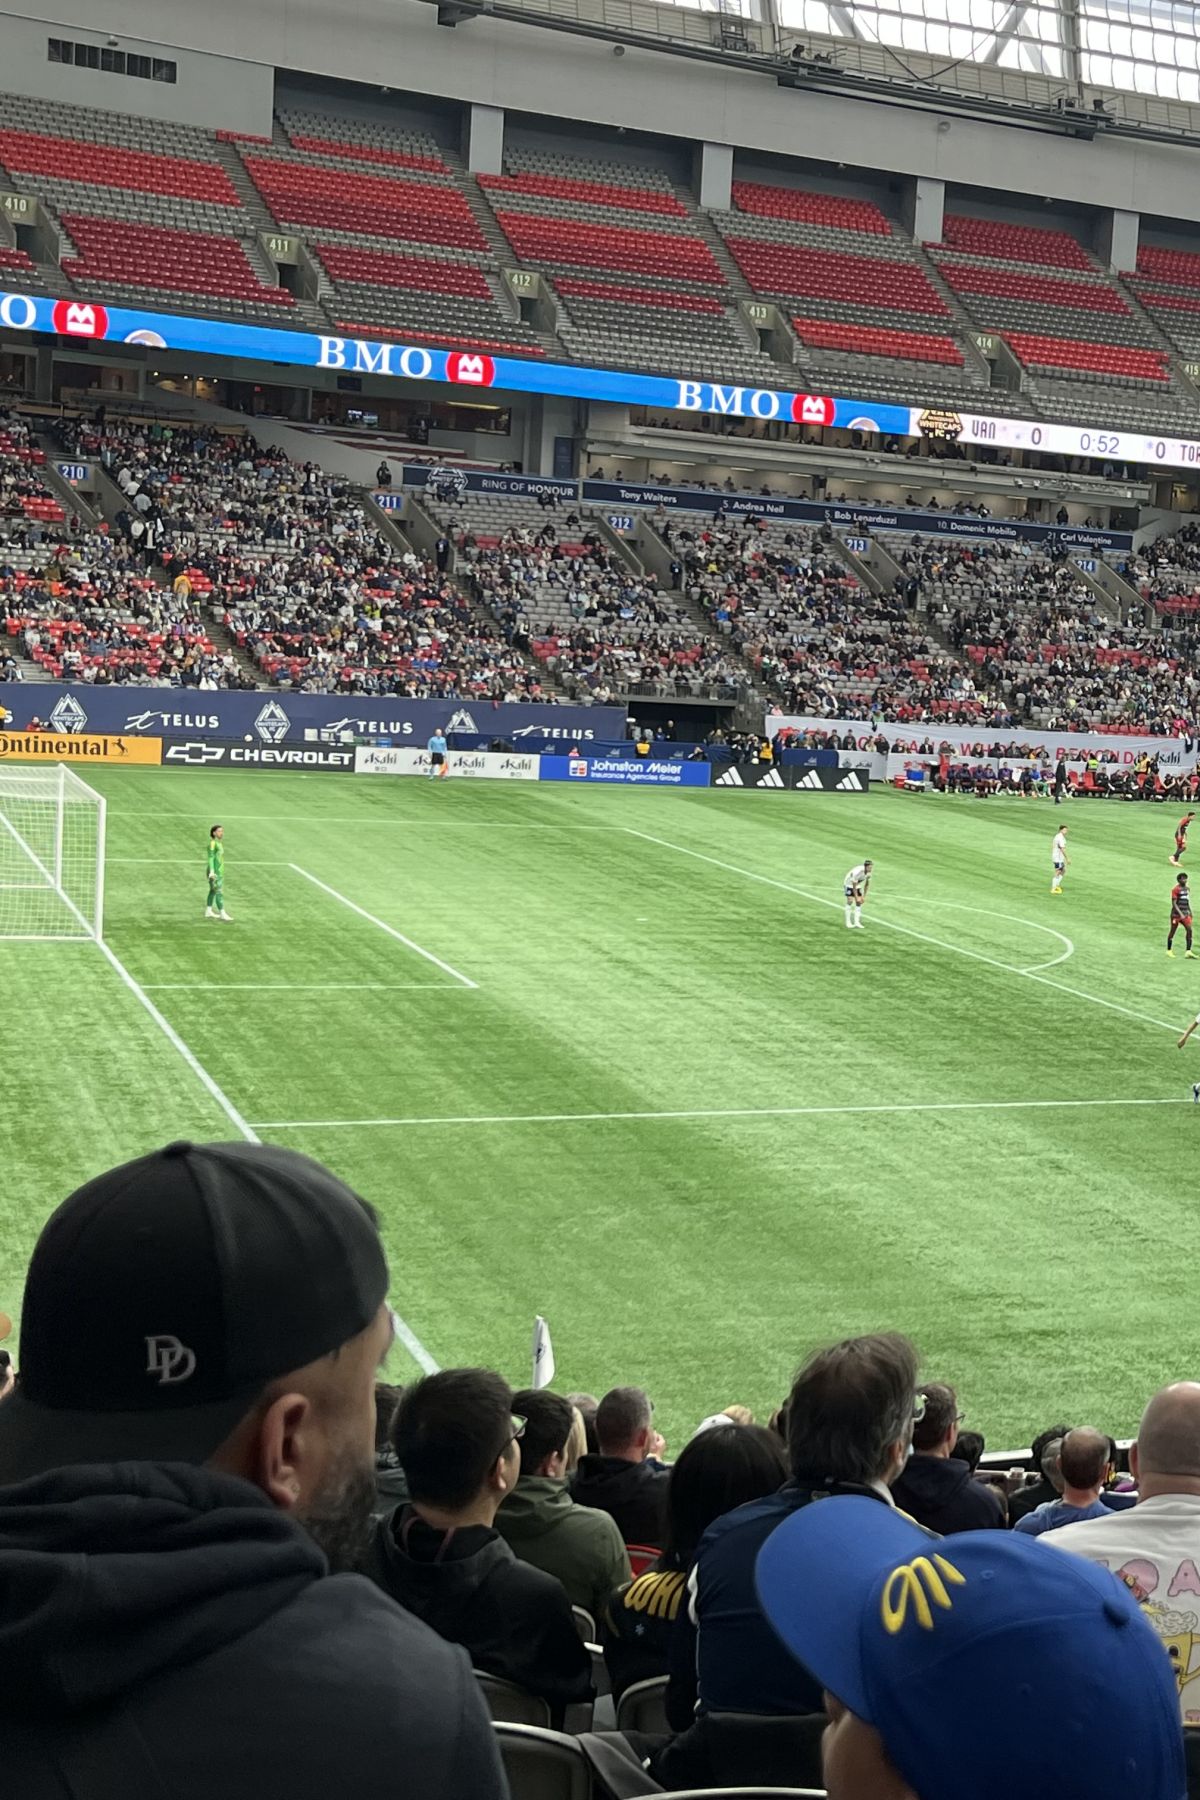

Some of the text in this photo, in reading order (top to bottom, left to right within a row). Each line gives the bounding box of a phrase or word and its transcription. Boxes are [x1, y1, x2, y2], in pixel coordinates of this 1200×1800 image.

[6, 198, 27, 213] 410
[269, 238, 289, 252] 411
[512, 274, 531, 287] 412
[750, 306, 767, 319] 413
[976, 336, 991, 348] 414
[317, 336, 432, 378] BMO
[676, 381, 779, 420] BMO
[972, 420, 996, 440] VAN
[1080, 433, 1120, 455] 0:52
[61, 465, 84, 480] 210
[481, 478, 574, 497] RING OF HONOUR
[378, 495, 399, 509] 211
[620, 490, 641, 502] Tony
[733, 501, 764, 513] Andrea
[610, 516, 630, 529] 212
[834, 511, 851, 521] Bob
[951, 522, 985, 534] Domenic
[988, 525, 1017, 536] Mobilio
[847, 539, 866, 552] 213
[1060, 533, 1076, 542] Carl
[1078, 534, 1112, 546] Valentine
[161, 714, 220, 728] TELUS
[357, 721, 413, 734] TELUS
[541, 728, 595, 740] TELUS
[230, 748, 353, 765] CHEVROLET
[364, 752, 397, 765] Asahi
[453, 755, 485, 768] Asahi
[500, 758, 532, 771] Asahi
[591, 760, 682, 774] Johnston Meier
[659, 775, 681, 783] Group
